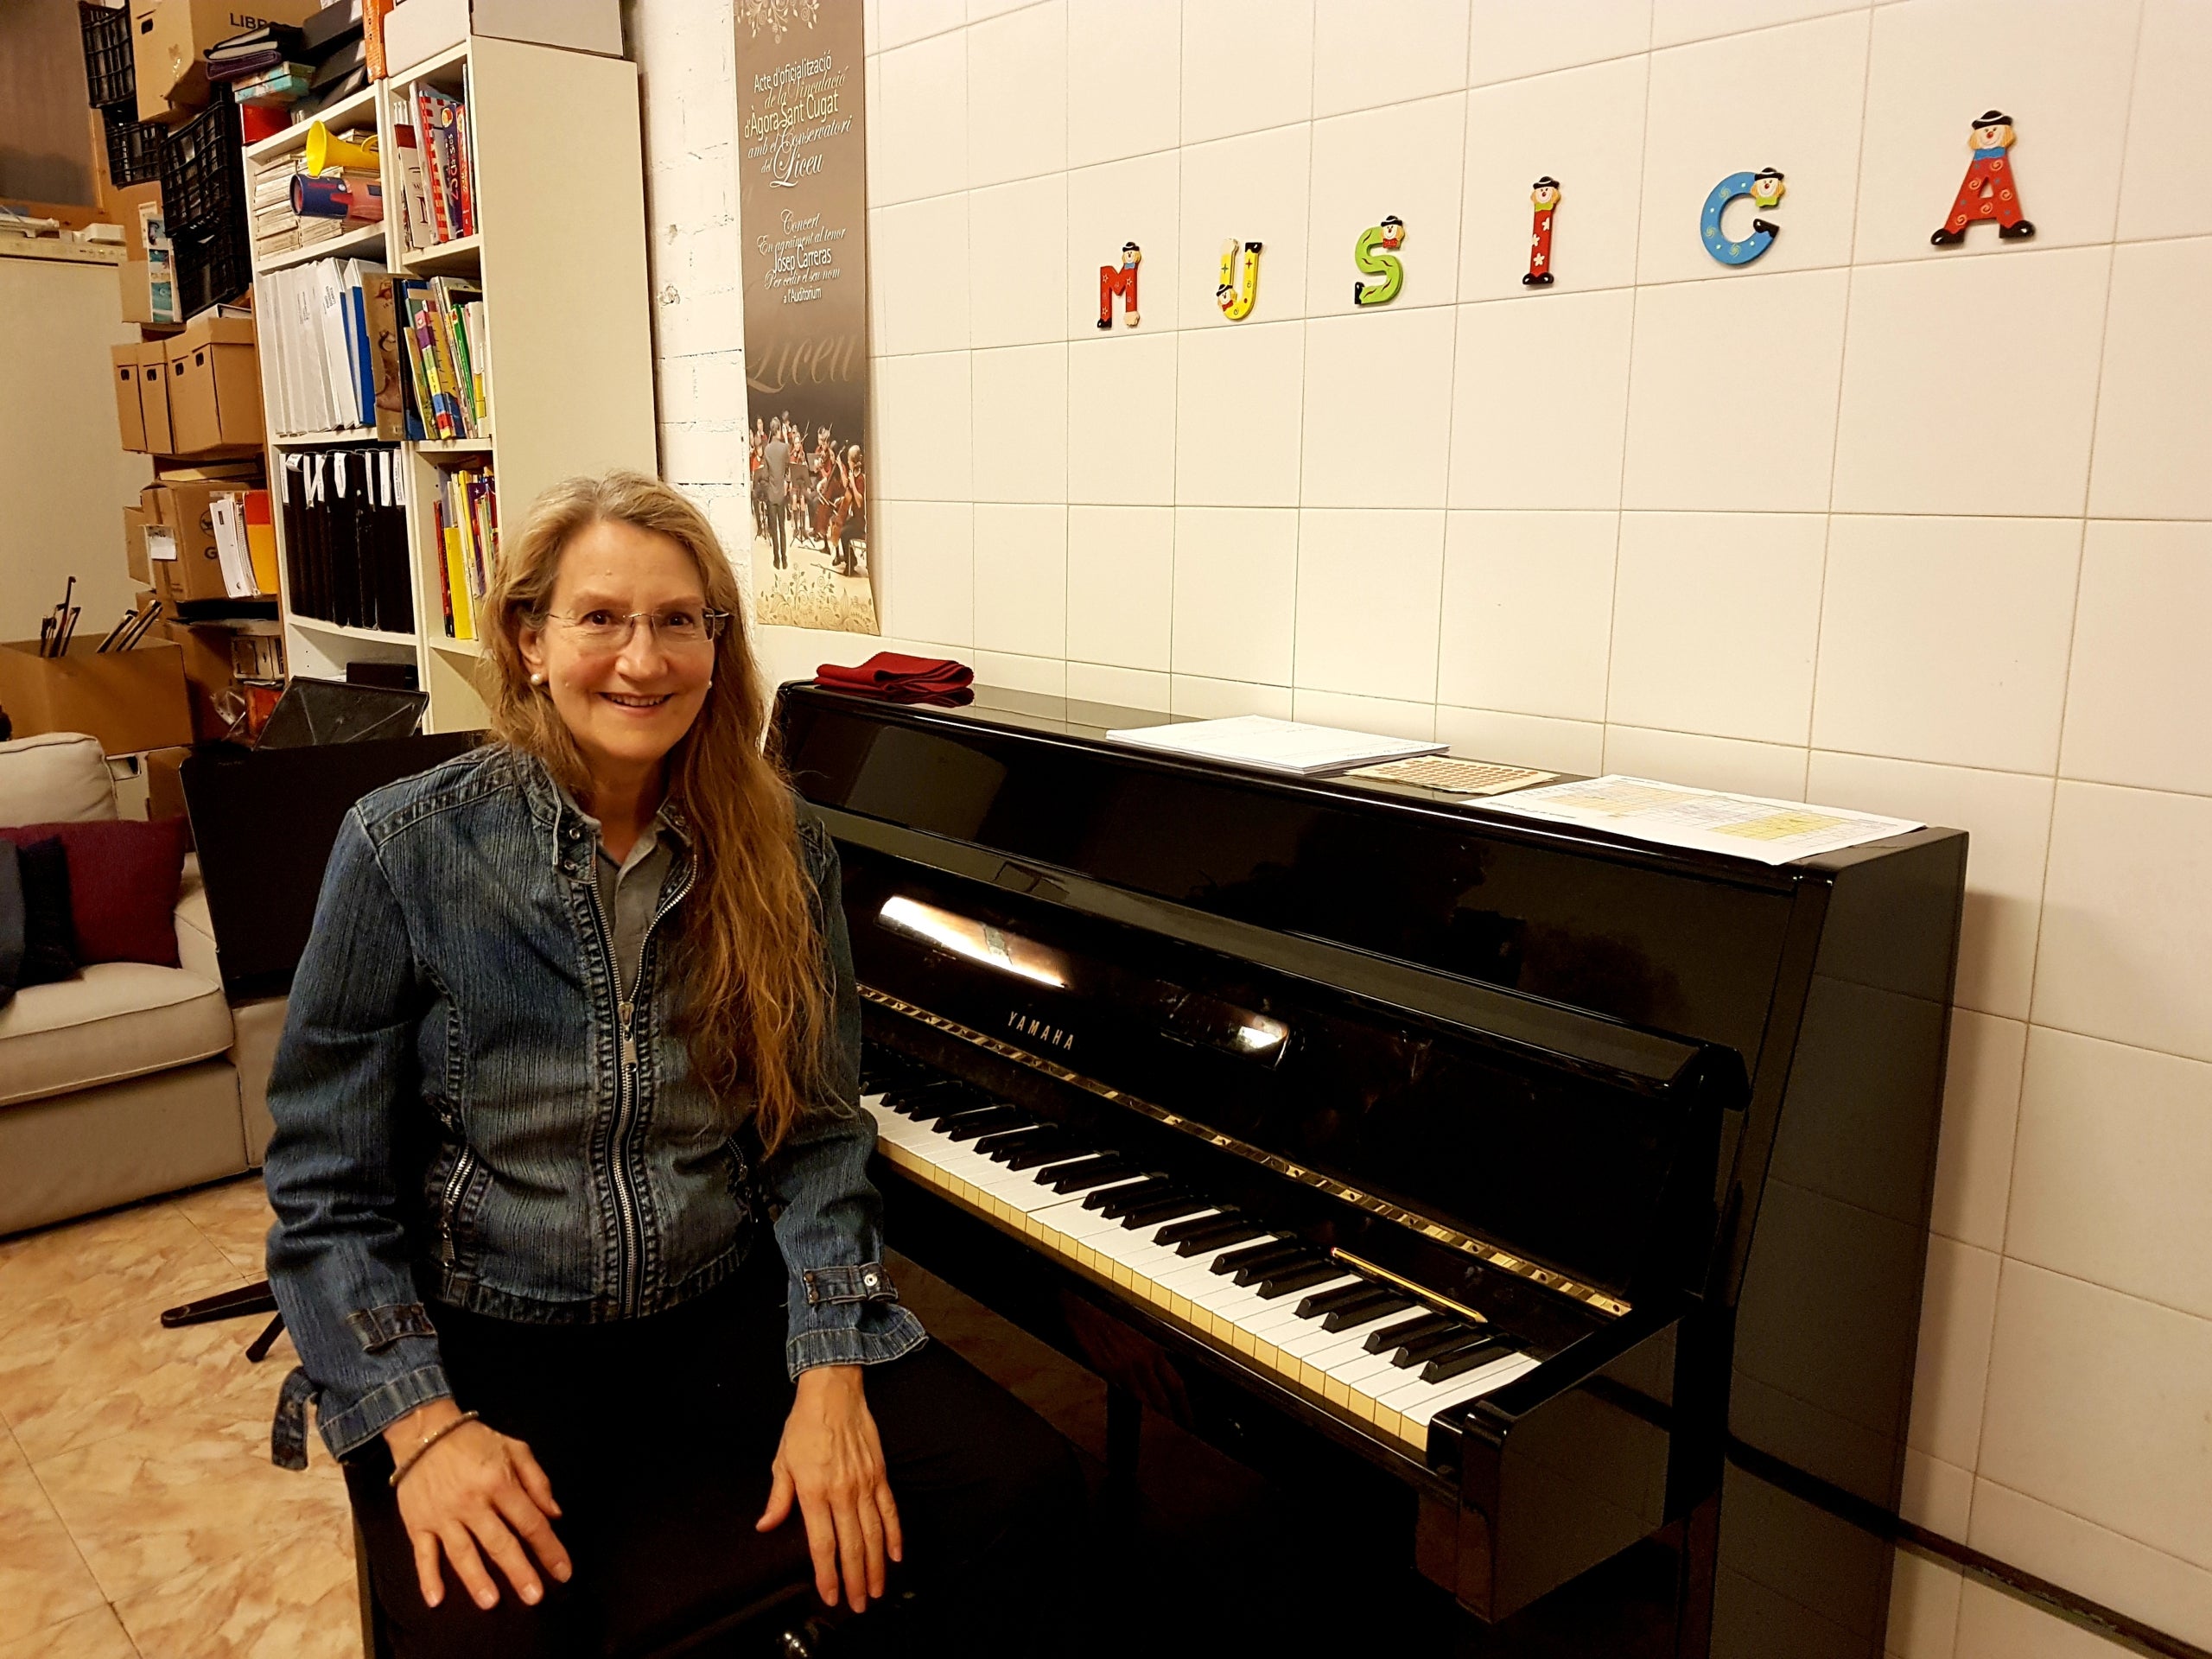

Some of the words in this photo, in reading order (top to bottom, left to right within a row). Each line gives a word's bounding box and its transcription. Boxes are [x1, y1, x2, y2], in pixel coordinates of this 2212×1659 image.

[229, 12, 269, 29] LIBR
[753, 74, 772, 93] Acte
[772, 49, 832, 87] d'oficialització
[764, 87, 776, 109] de
[777, 83, 787, 105] la
[744, 105, 779, 141] d'Àgora
[780, 100, 804, 128] Sant
[806, 89, 838, 123] Cugat
[747, 137, 768, 159] amb
[778, 115, 853, 154] Conservatori
[761, 157, 773, 174] del
[769, 143, 824, 188] Liceu
[780, 208, 821, 235] Concert
[757, 234, 773, 256] En
[815, 226, 825, 243] al
[824, 227, 847, 242] tenor
[772, 247, 796, 276] Josep
[797, 244, 832, 269] Carreras
[764, 269, 782, 290] Per
[783, 270, 802, 286] cedir
[822, 268, 841, 280] nom
[787, 285, 822, 303] l'Auditorium
[1007, 1010, 1075, 1051] YAMAHA
